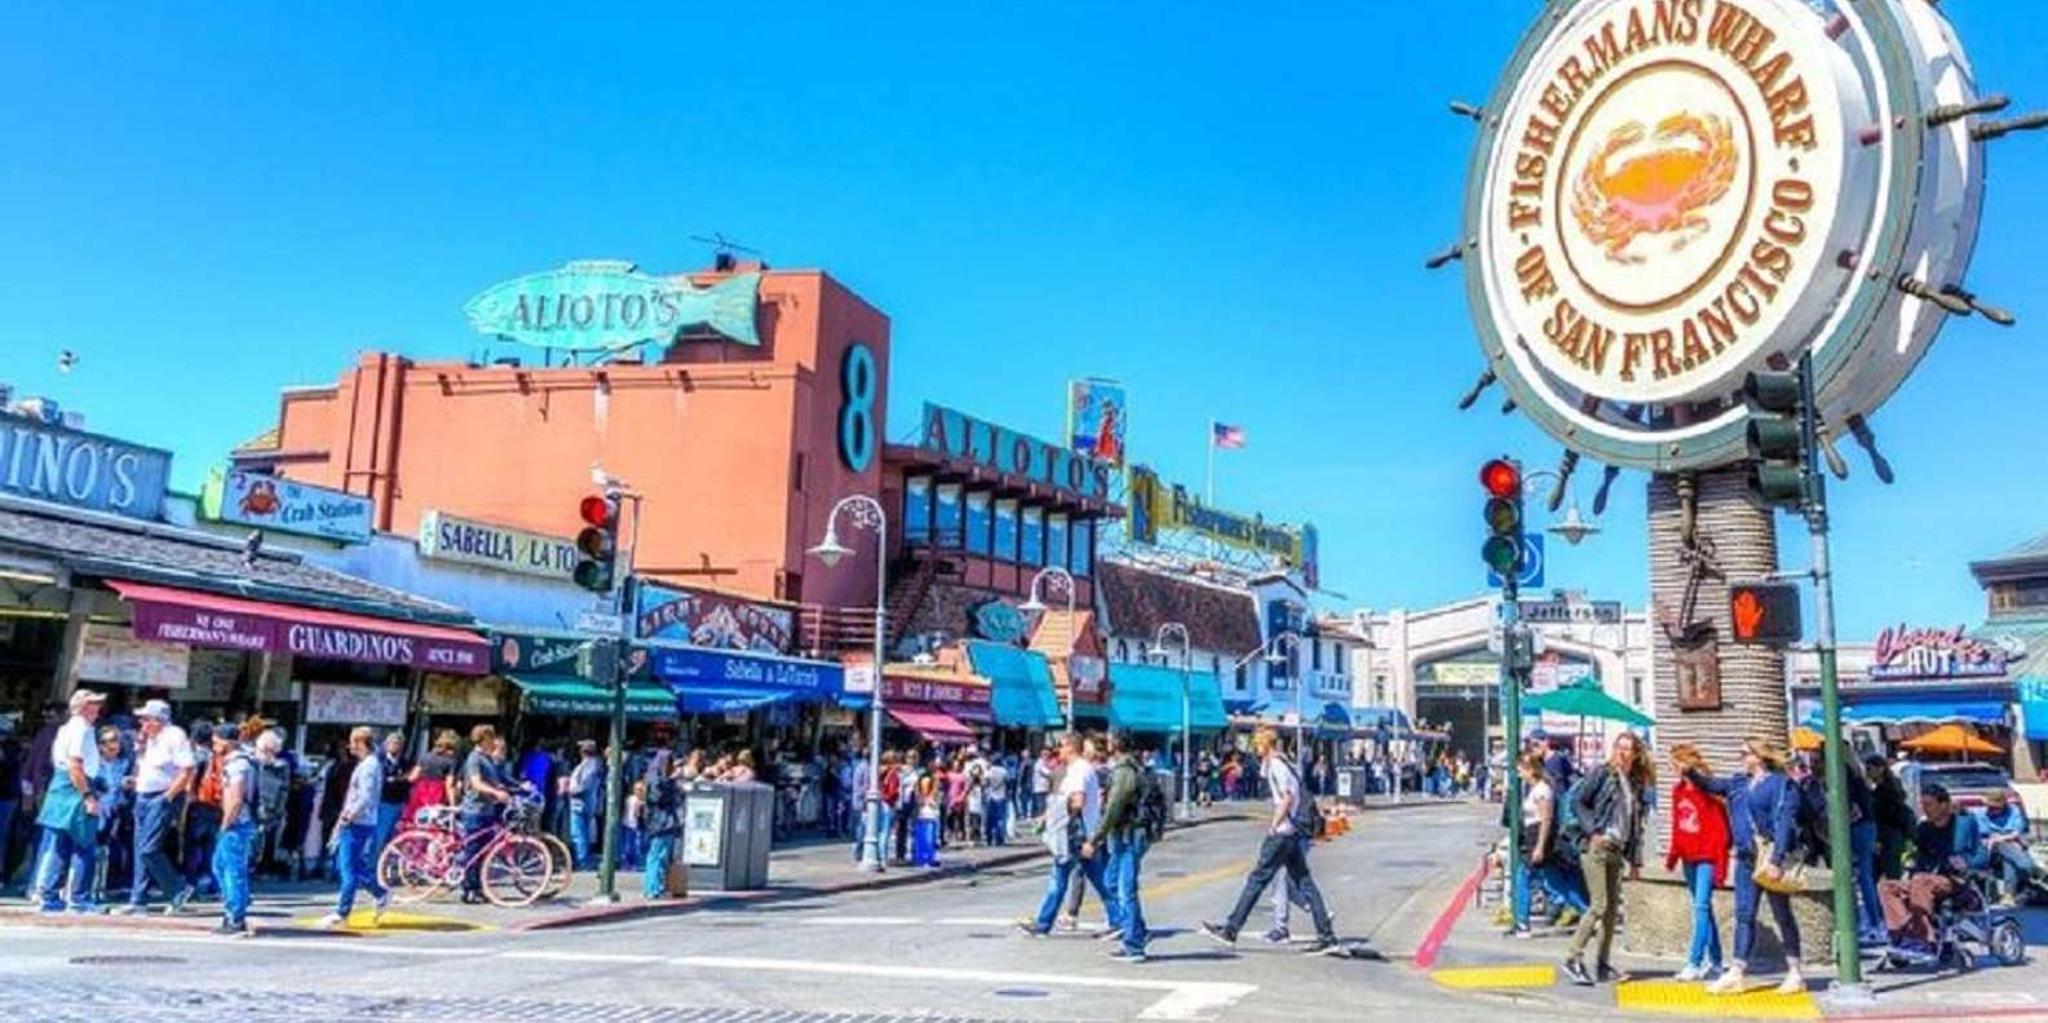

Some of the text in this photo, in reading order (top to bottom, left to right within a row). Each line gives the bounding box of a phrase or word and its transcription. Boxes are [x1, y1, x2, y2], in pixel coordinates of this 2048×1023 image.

[1508, 0, 1818, 231] FISHERMANS WHARF
[1513, 177, 1816, 383] OF SAN FRANCISCO
[508, 288, 681, 331] ALIOTO'S
[838, 341, 876, 474] 8
[0, 426, 139, 509] INO'S
[926, 405, 1110, 499] ALIOTO'S
[440, 522, 576, 573] SABELLA LA TO
[1528, 605, 1616, 620] Jefferson
[288, 624, 415, 665] GUARDINO'S
[725, 658, 762, 682] Sabella
[1908, 645, 1952, 676] HUT
